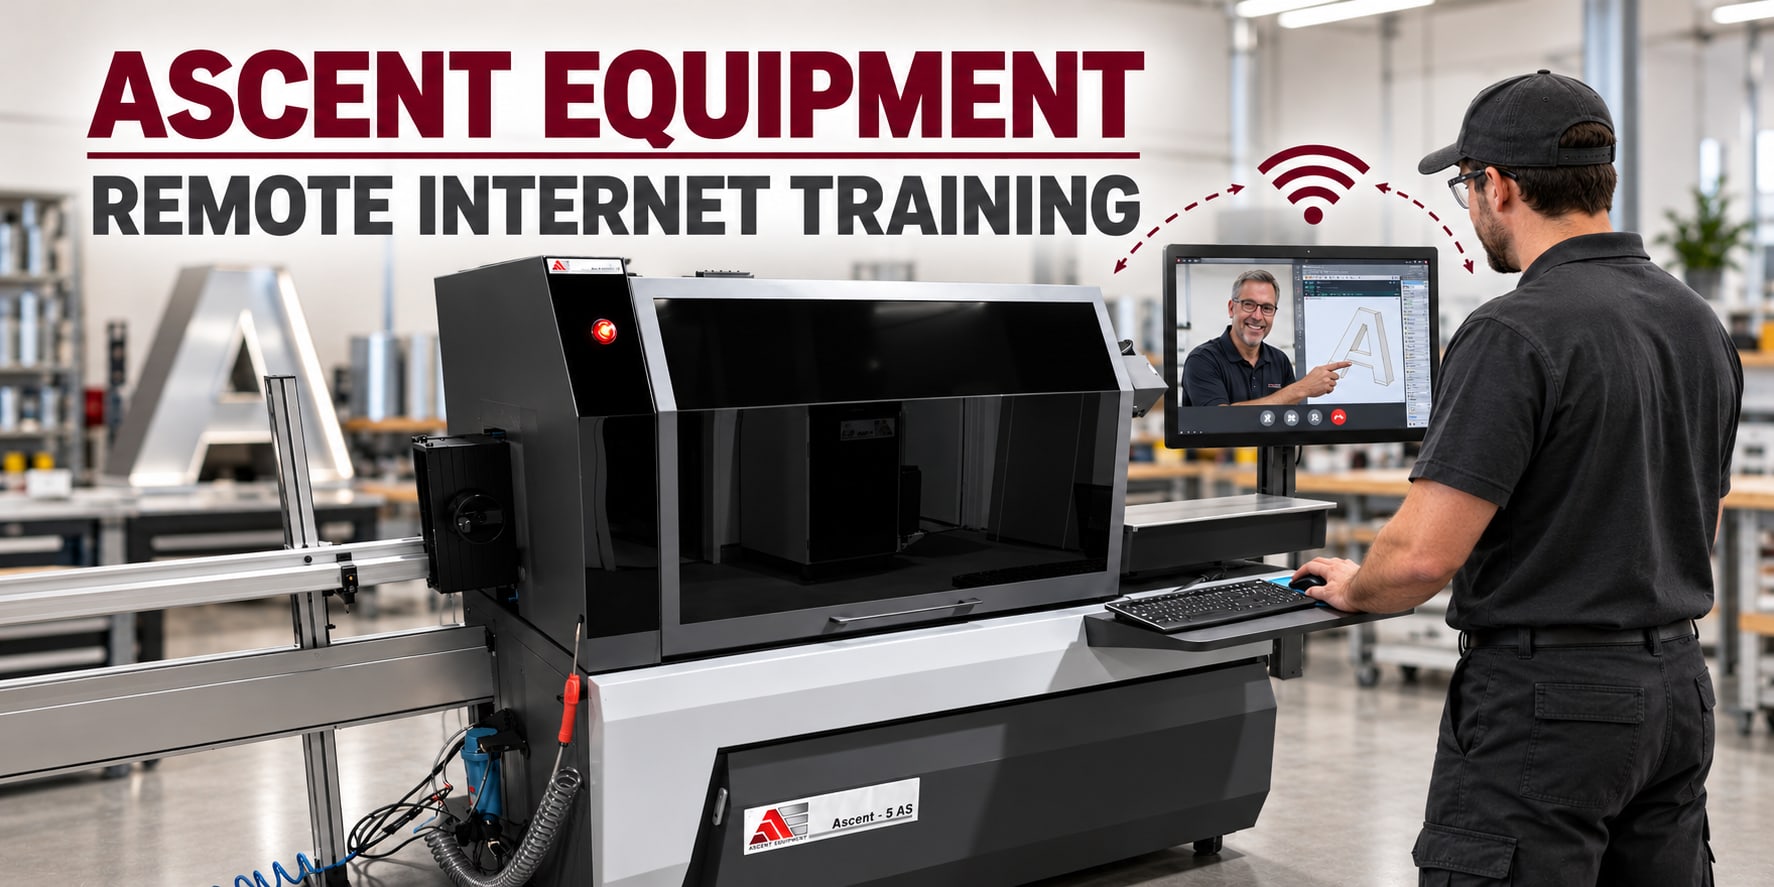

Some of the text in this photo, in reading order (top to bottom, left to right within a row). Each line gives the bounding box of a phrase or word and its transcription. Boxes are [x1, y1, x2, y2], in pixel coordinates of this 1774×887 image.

[832, 811, 875, 830] Ascent
[885, 807, 894, 819] 5
[896, 803, 914, 817] AS
[748, 842, 772, 851] ASCENT
